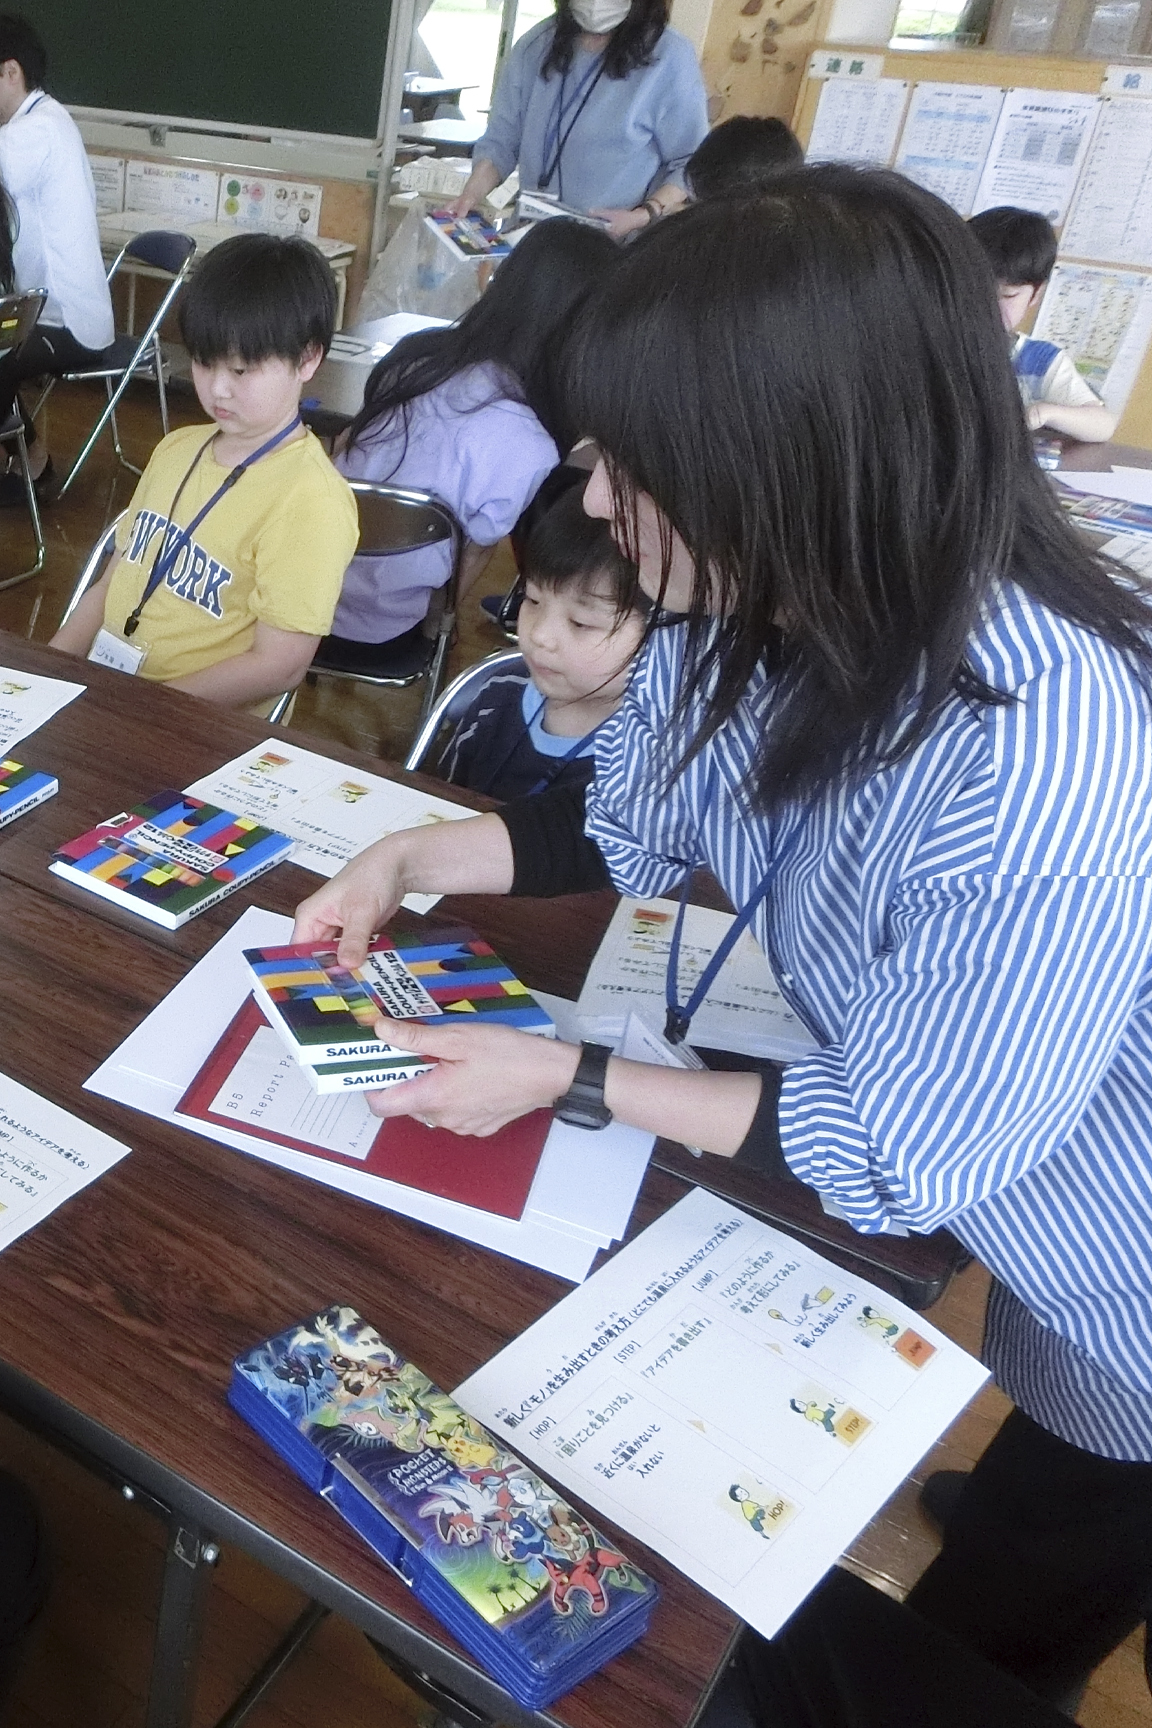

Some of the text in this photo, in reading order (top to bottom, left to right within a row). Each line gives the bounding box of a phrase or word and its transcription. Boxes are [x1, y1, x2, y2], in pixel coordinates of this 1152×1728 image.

[161, 849, 210, 873] SAKURA
[188, 894, 221, 919] SAKURA
[383, 952, 398, 963] 12
[367, 954, 417, 1015] COUPY-PENCIL
[373, 981, 404, 1016] SAKURA
[326, 1044, 392, 1057] SAKURA
[343, 1072, 408, 1086] SAKURA
[226, 1092, 244, 1110] B5
[250, 1074, 284, 1117] Report
[392, 1448, 435, 1478] POCKET
[635, 1450, 665, 1478] 入れない
[767, 1499, 789, 1521] HOP!
